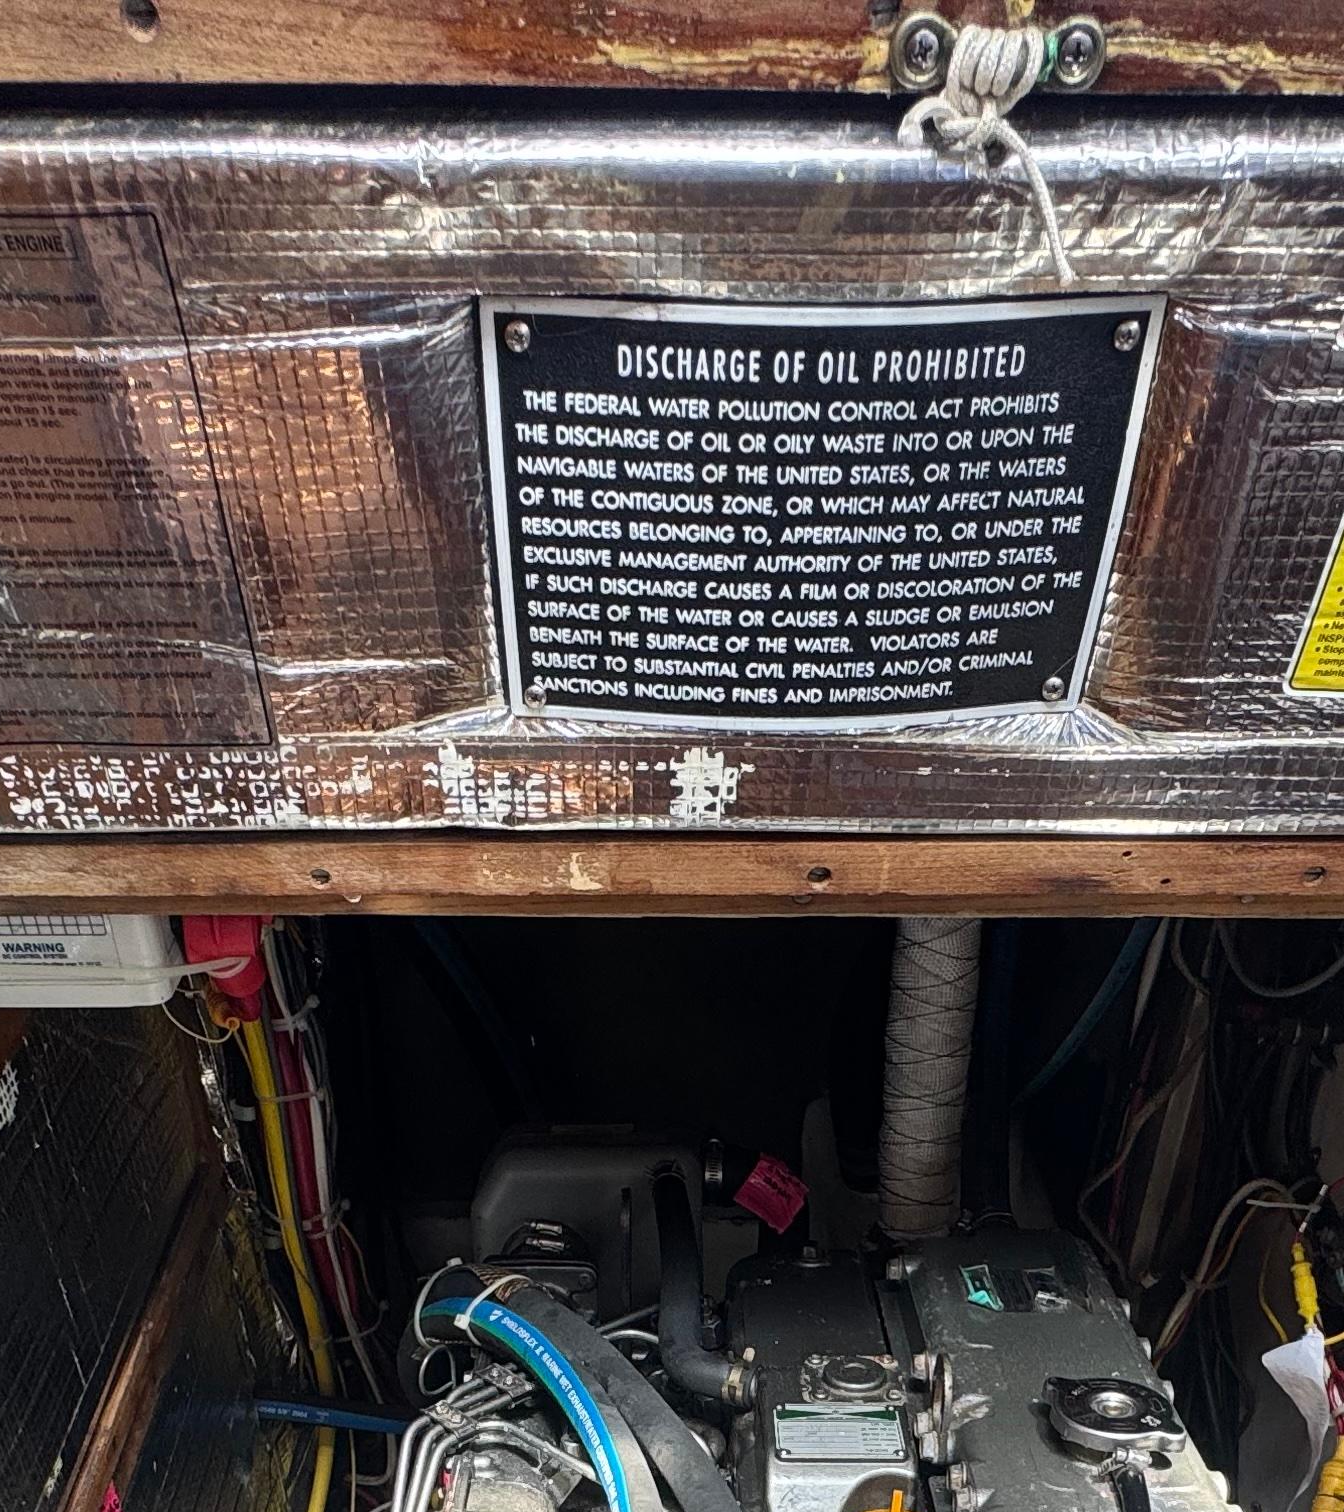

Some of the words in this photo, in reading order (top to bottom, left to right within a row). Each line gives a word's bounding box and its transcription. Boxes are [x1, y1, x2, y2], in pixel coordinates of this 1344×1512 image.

[4, 235, 64, 252] ENGINE
[617, 345, 761, 382] DISCHARGE
[774, 350, 806, 383] OF
[818, 351, 859, 384] OIL
[873, 345, 1026, 382] PROHIBITED
[523, 390, 557, 413] THE
[564, 392, 642, 417] FEDERAL
[648, 397, 710, 419] WATER
[718, 400, 821, 422] POLLUTION
[828, 401, 918, 422] CONTROL
[925, 398, 964, 419] ACT
[970, 392, 1060, 417] PROHIBITS
[515, 423, 549, 445] THE
[555, 425, 660, 450] DISCHARGE
[667, 430, 694, 451] OF
[701, 432, 732, 453] OIL
[738, 433, 767, 453] OR
[773, 434, 816, 454] OILY
[822, 433, 885, 454] WASTE
[893, 432, 939, 452] INTO
[946, 430, 973, 451] OR
[981, 427, 1035, 449] UPON
[1042, 424, 1075, 445] THE
[517, 456, 617, 479] NAVIGABLE
[624, 461, 695, 483] WATERS
[702, 463, 728, 484] OF
[736, 465, 769, 485] THE
[776, 466, 843, 485] UNITED
[850, 465, 915, 486] STATES,
[923, 463, 951, 483] OR
[959, 461, 991, 480] THE
[999, 456, 1067, 477] WATERS
[519, 486, 545, 506] OF
[551, 488, 584, 509] THE
[591, 490, 714, 514] CONTIGUOUS
[721, 495, 778, 517] ZONE,
[786, 496, 814, 516] OR
[820, 496, 884, 515] WHICH
[890, 494, 931, 513] MAY
[936, 491, 1002, 511] AFFECT
[1007, 486, 1085, 508] NATURAL
[521, 517, 622, 539] RESOURCES
[629, 522, 735, 544] BELONGING
[742, 525, 772, 547] TO,
[780, 525, 907, 545] APPERTAINING
[914, 524, 943, 543] TO,
[951, 522, 977, 541] OR
[985, 518, 1044, 539] UNDER
[1052, 515, 1082, 534] THE
[2, 942, 66, 953] WARNING
[558, 1374, 573, 1393] WET
